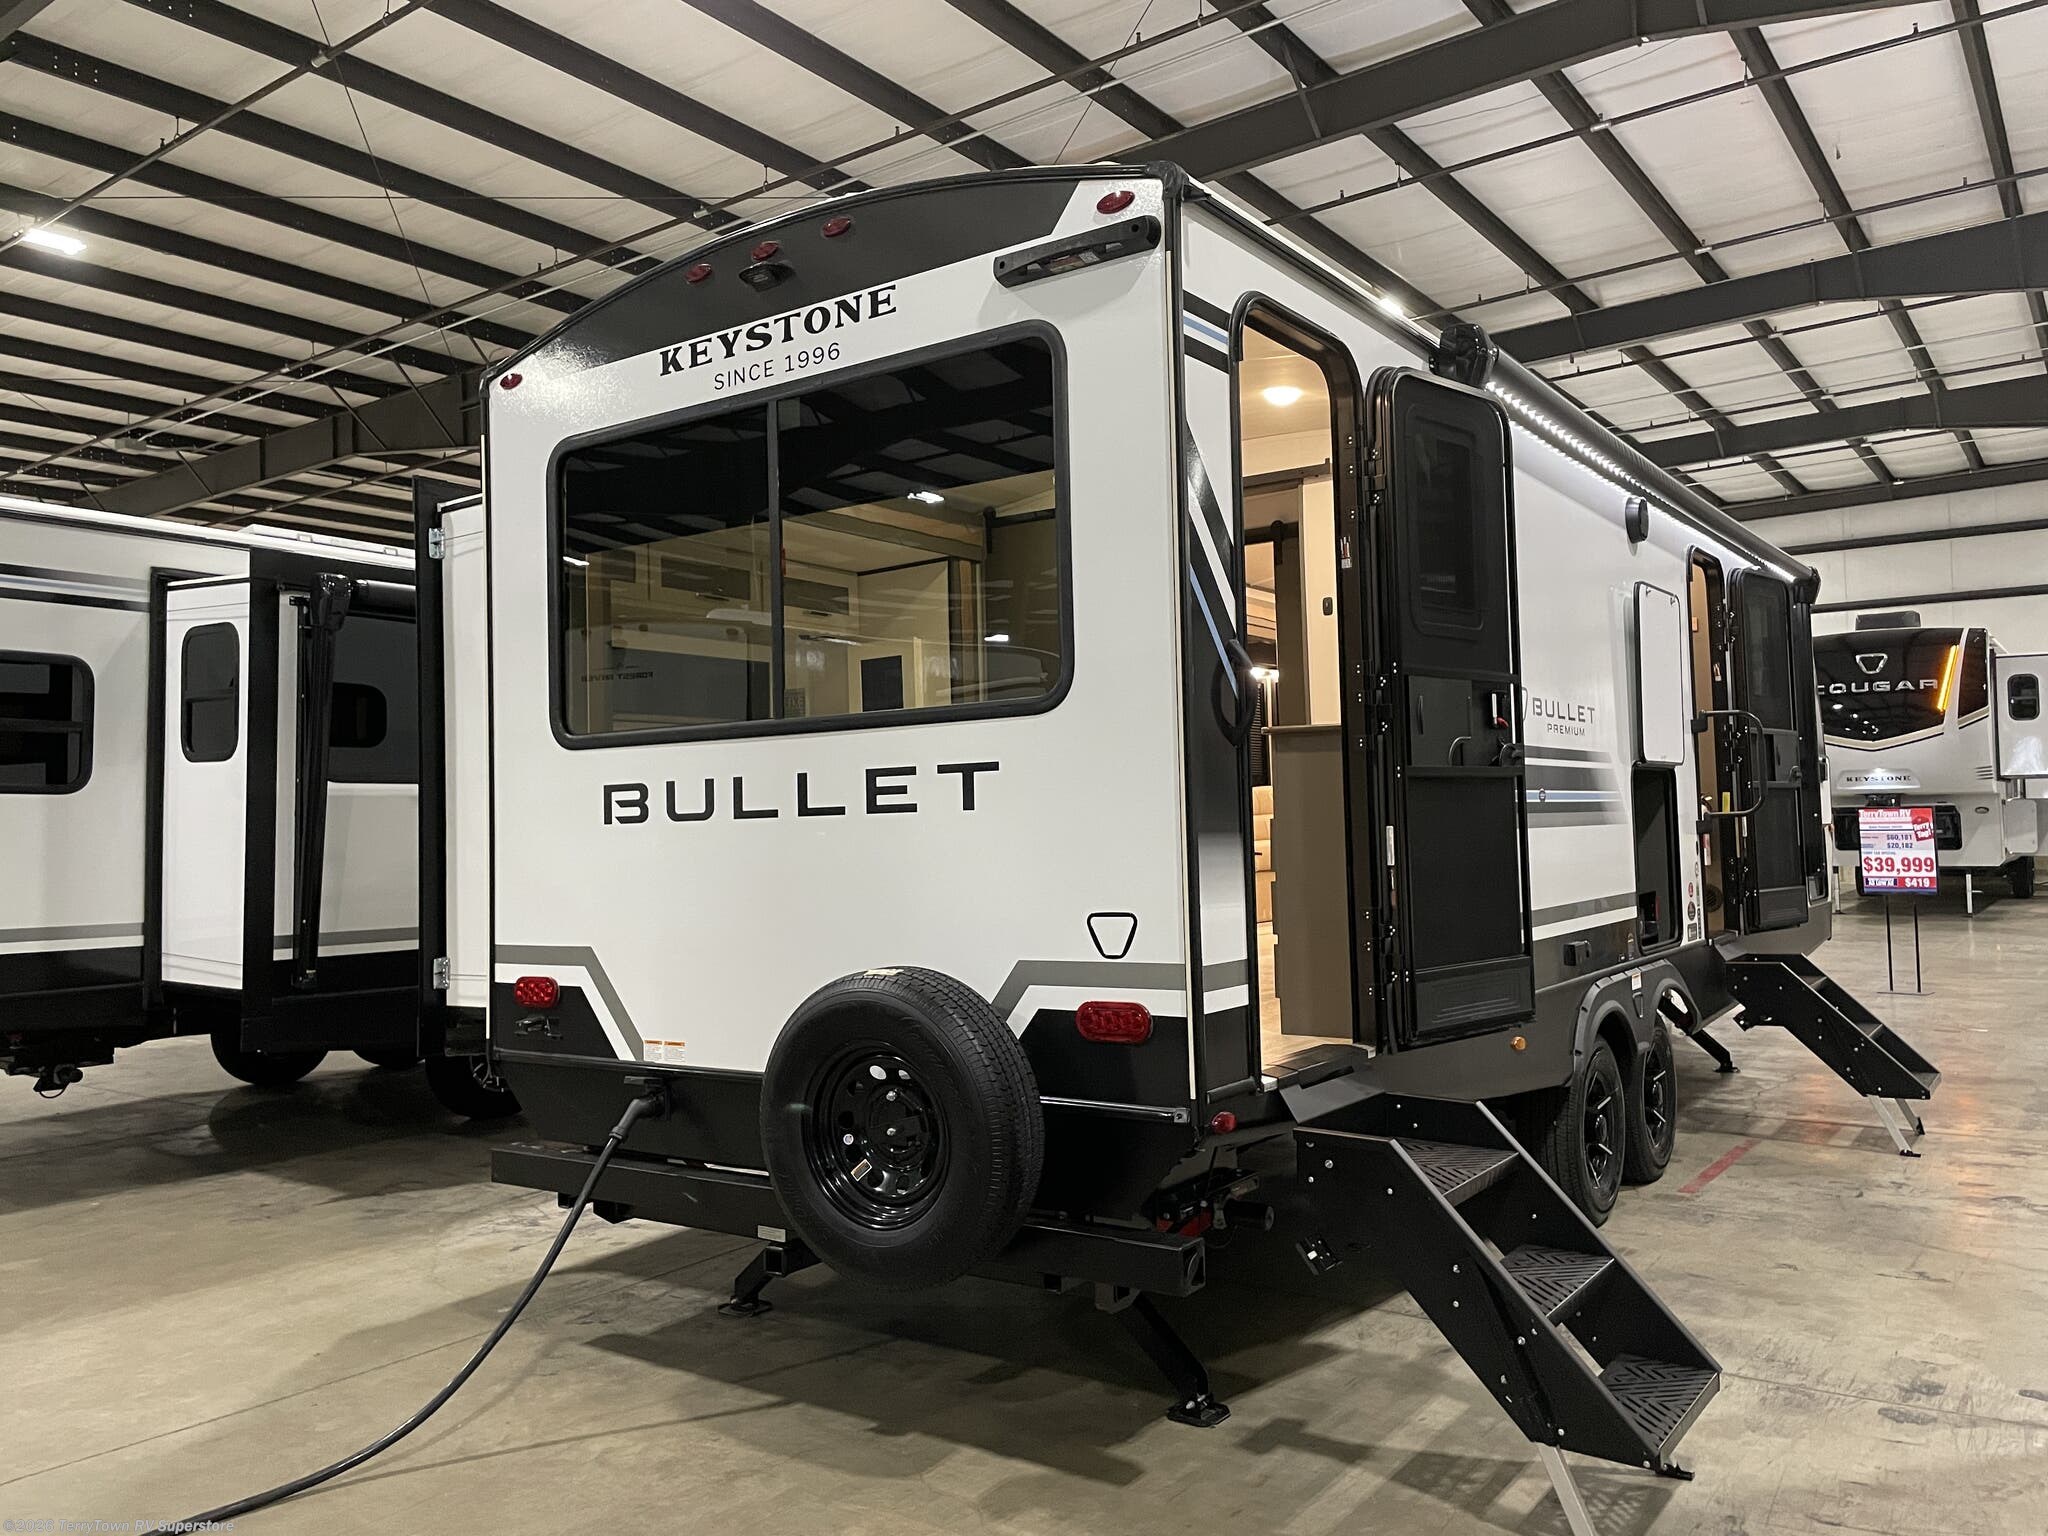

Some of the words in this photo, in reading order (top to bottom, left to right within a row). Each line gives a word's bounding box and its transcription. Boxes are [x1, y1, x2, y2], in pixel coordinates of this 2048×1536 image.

[659, 284, 897, 377] KEYSTONE
[714, 359, 775, 391] SINCE
[784, 342, 841, 373] 1996
[1532, 697, 1596, 724] BULLET
[1547, 723, 1586, 736] PREMIUM
[603, 761, 1000, 825] BULLET
[1863, 856, 1935, 875] $39,999
[1905, 878, 1930, 888] $419
